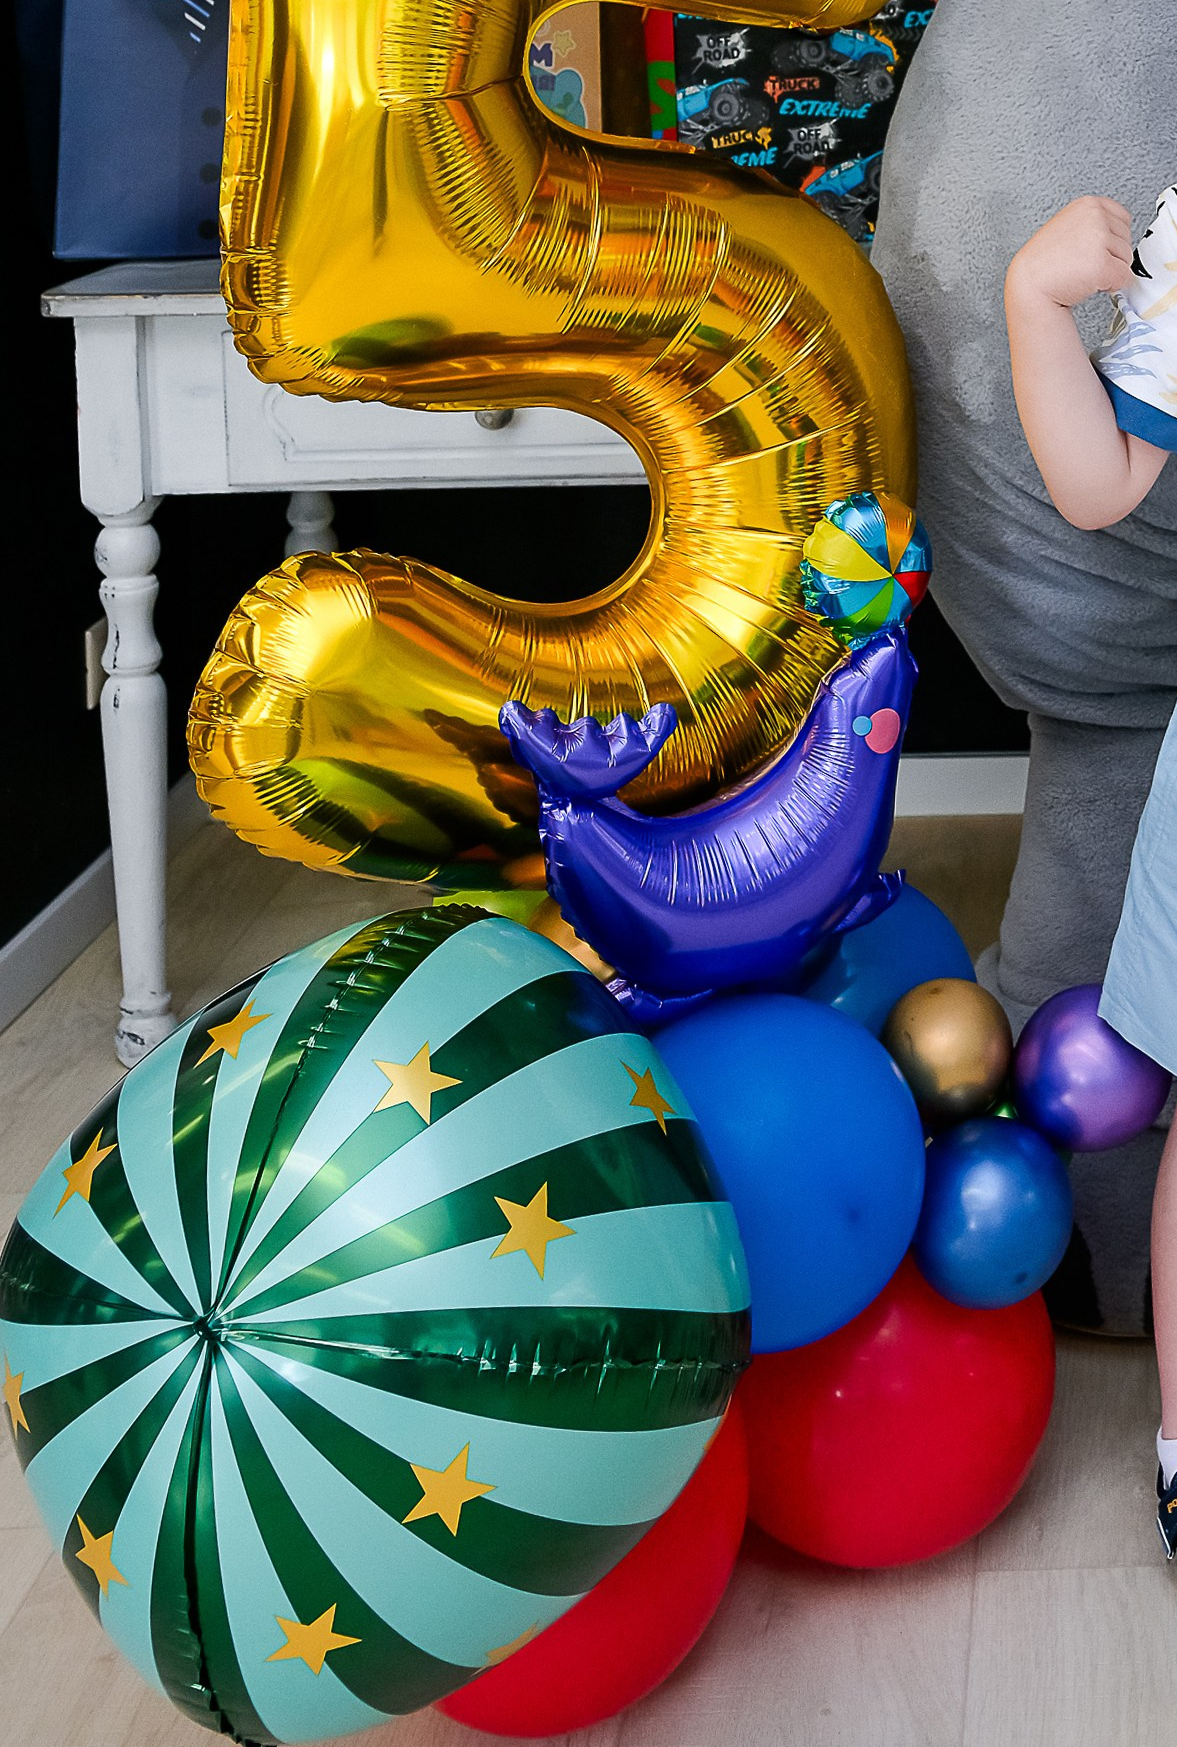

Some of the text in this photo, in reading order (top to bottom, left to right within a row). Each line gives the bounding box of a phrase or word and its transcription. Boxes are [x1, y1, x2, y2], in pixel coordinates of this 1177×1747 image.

[706, 36, 731, 48] OFF
[703, 48, 741, 62] ROAD
[769, 79, 817, 91] TRUCK
[797, 127, 822, 141] OFF
[793, 141, 832, 153] ROAD
